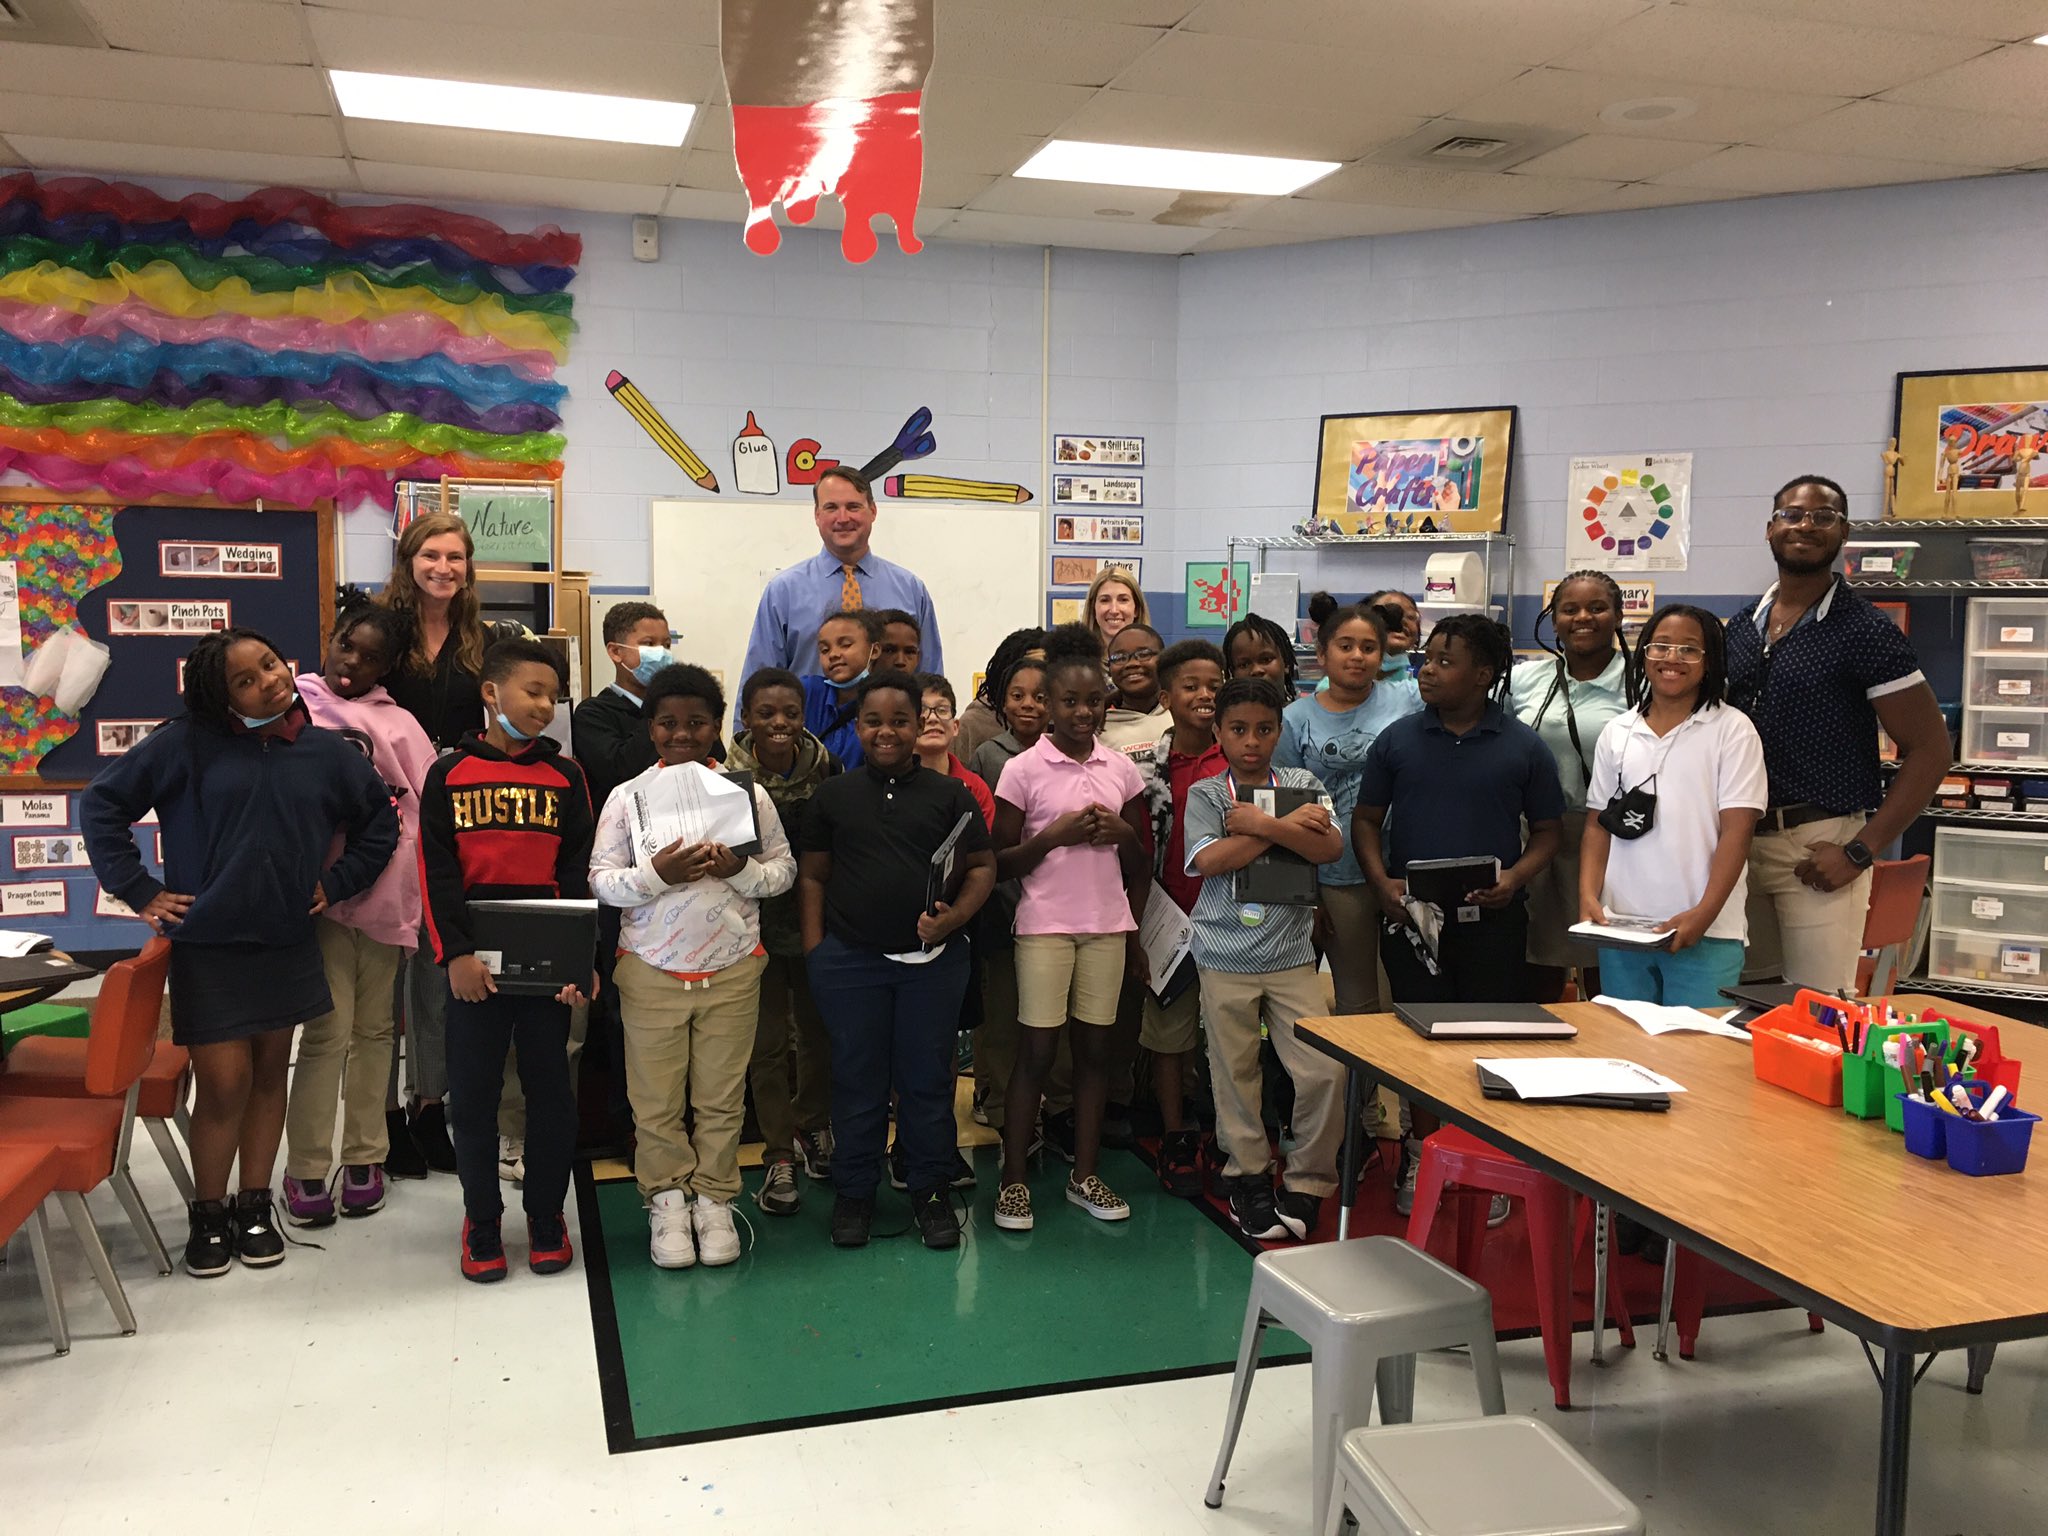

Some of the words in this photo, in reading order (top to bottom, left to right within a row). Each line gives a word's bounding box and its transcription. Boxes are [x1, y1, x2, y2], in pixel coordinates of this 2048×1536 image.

[738, 442, 768, 454] Glue
[1107, 440, 1122, 450] Still
[1123, 441, 1139, 451] Lifes
[1355, 448, 1433, 481] Paper
[1103, 479, 1136, 489] Landscapes
[1355, 476, 1437, 511] Crafts
[470, 501, 534, 537] Nature
[1100, 518, 1120, 526] Portraits
[1125, 519, 1140, 527] Figures
[225, 547, 273, 561] Wedging
[171, 604, 200, 617] Pinch
[202, 605, 225, 618] Pots
[1123, 742, 1154, 752] WORK
[22, 799, 53, 811] Molas
[452, 787, 560, 829] HUSTLE
[24, 811, 51, 819] Panama
[7, 891, 32, 899] Dragon
[33, 890, 62, 898] Costume
